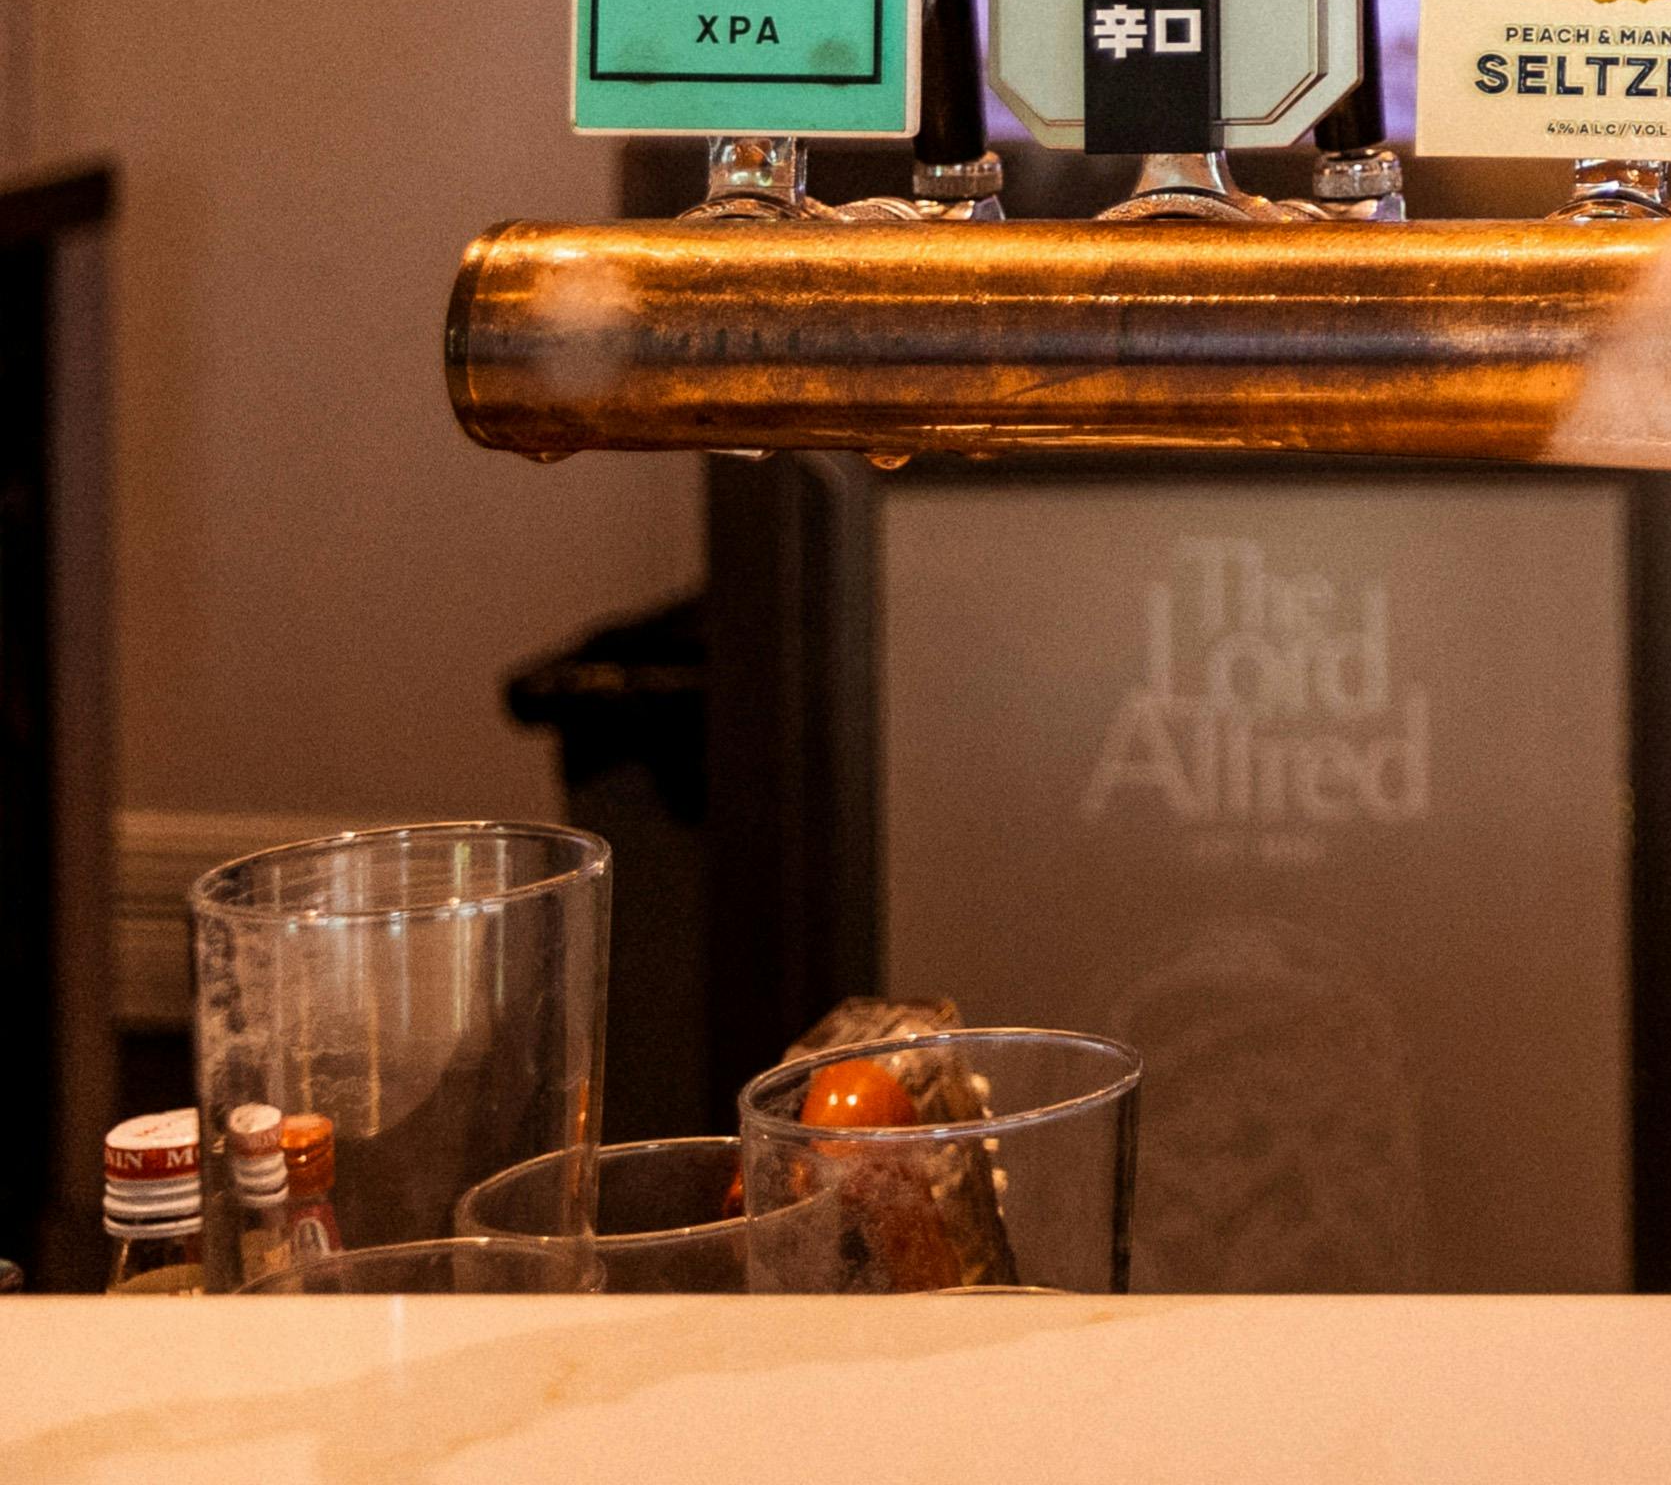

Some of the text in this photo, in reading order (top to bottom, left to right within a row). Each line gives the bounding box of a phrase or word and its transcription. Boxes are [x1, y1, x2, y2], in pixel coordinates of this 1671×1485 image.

[696, 14, 780, 45] XPA
[1093, 4, 1201, 60] 辛口
[1505, 27, 1589, 45] PEACH
[1599, 29, 1611, 45] &
[1175, 535, 1336, 634] The
[1147, 581, 1390, 716] Lord
[1080, 686, 1431, 820] Alfred
